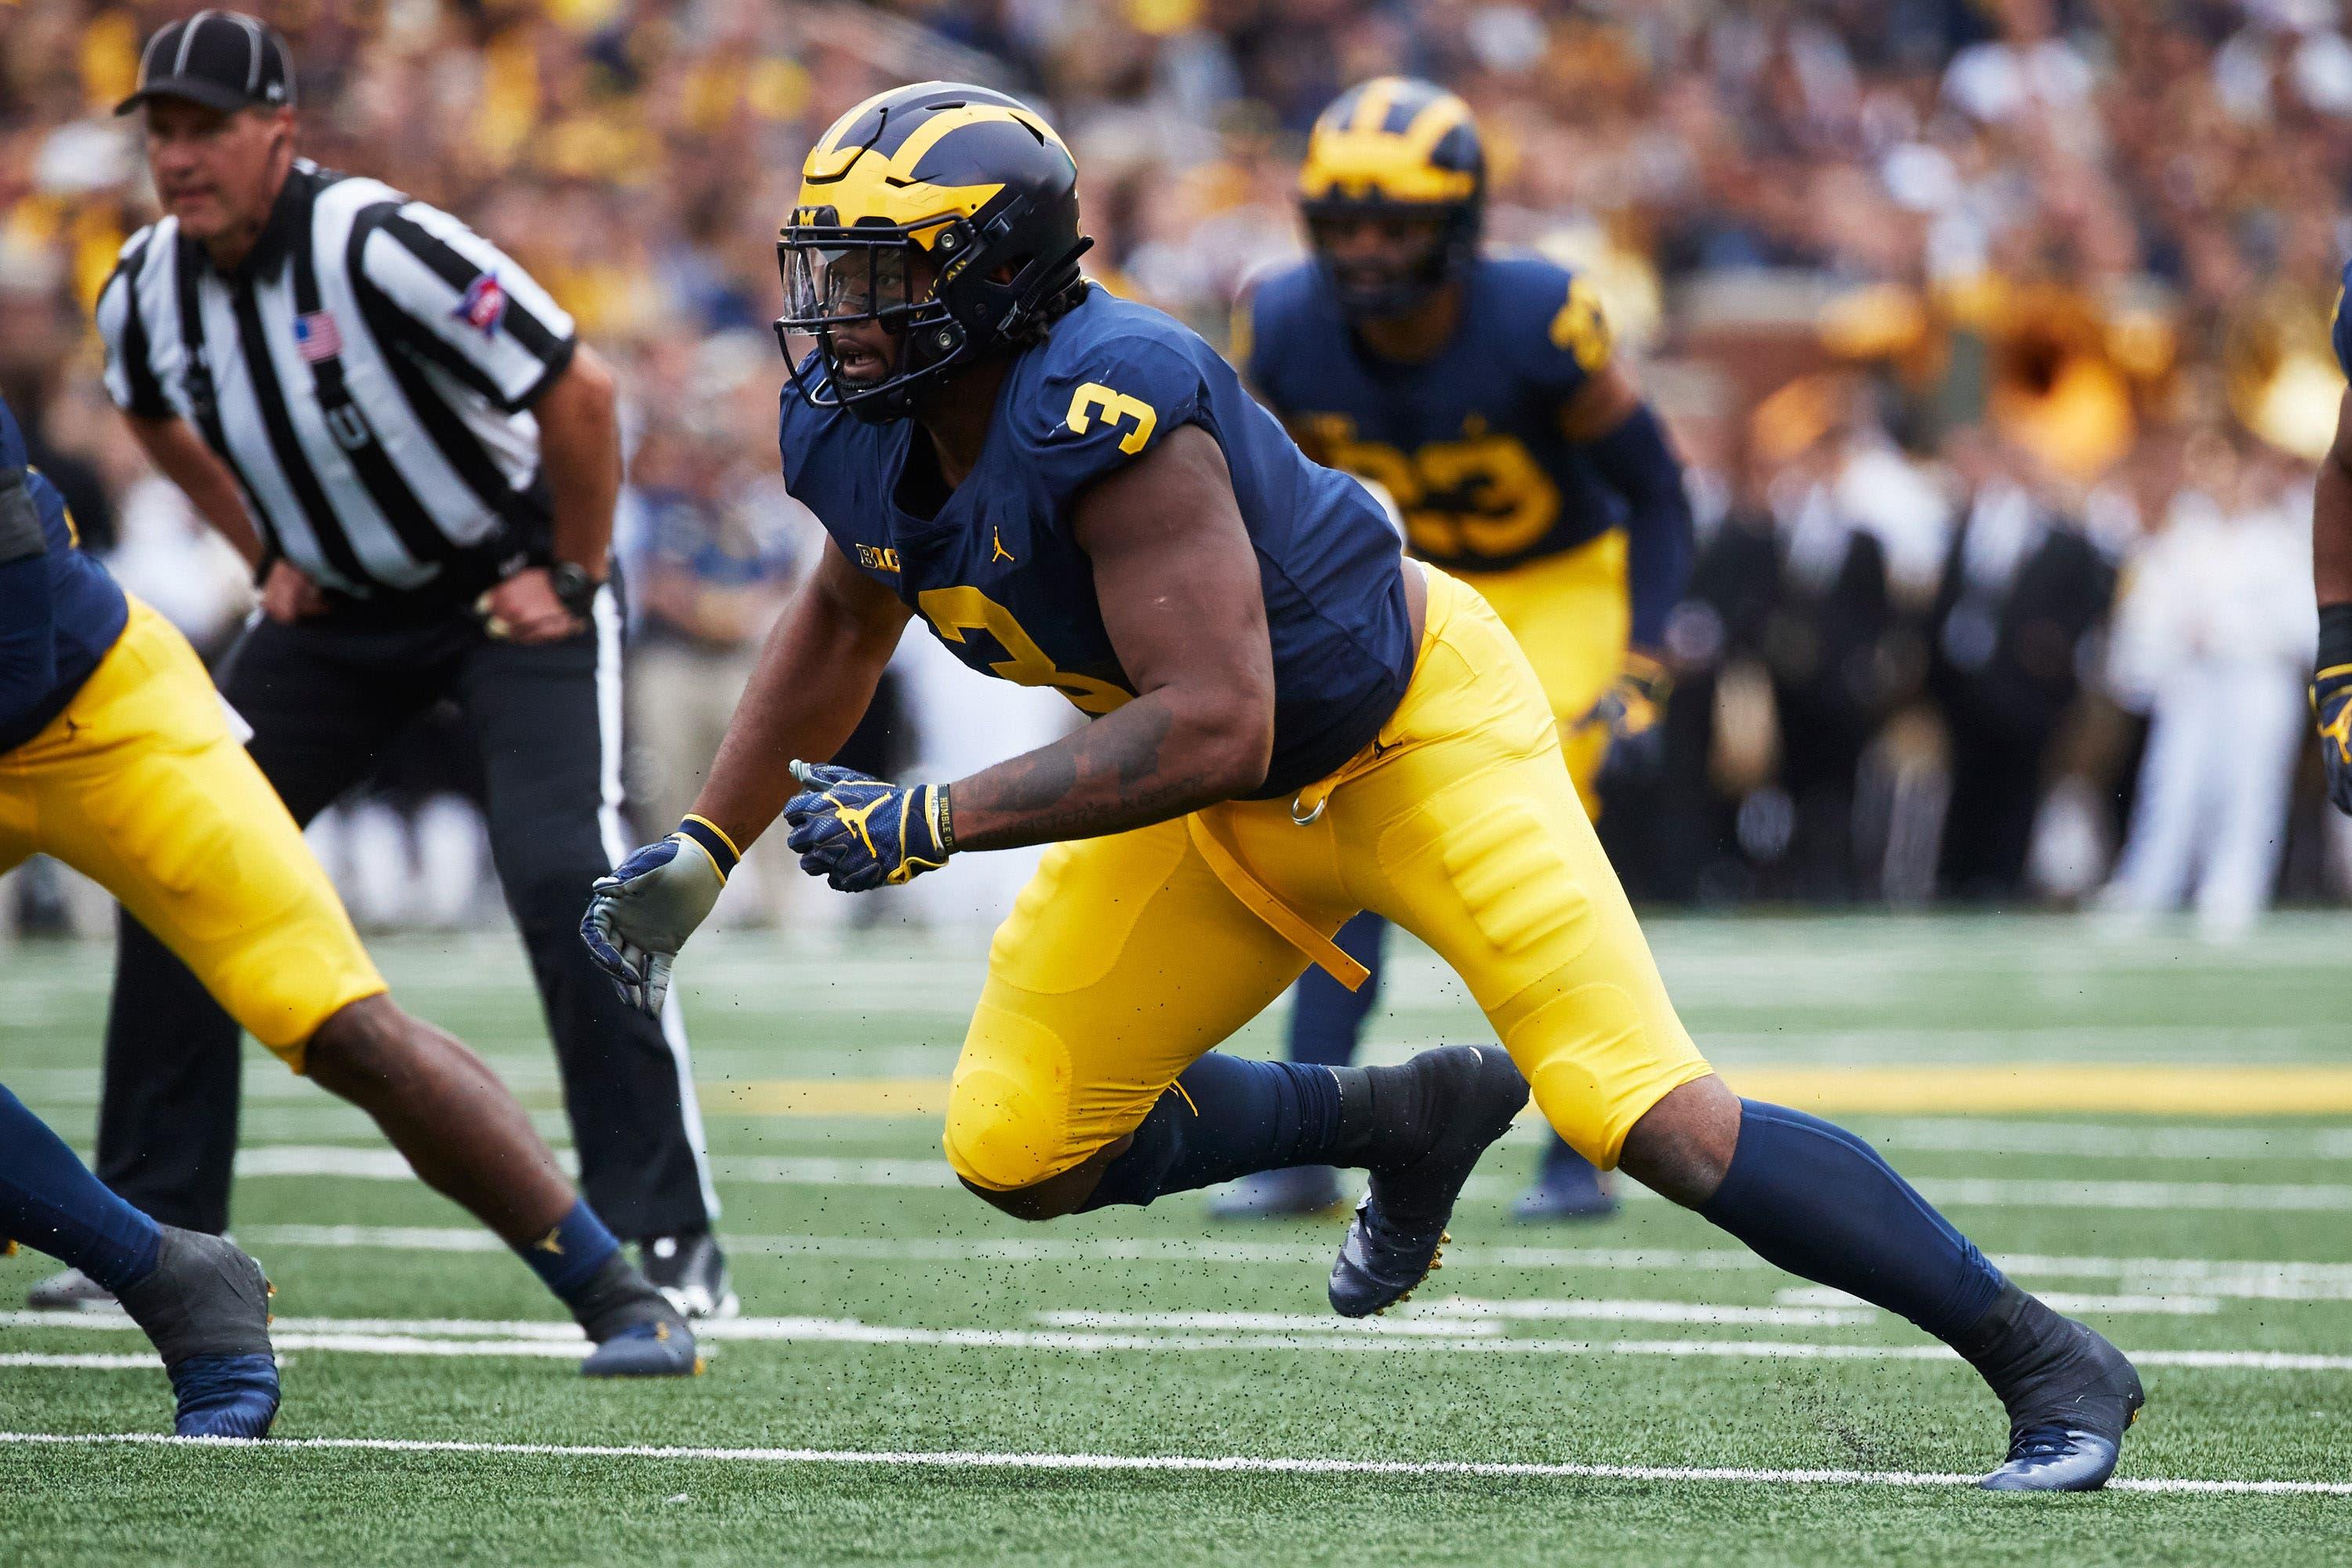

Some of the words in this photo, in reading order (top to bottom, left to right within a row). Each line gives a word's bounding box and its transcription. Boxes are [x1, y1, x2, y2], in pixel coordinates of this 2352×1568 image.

[799, 209, 816, 226] M
[1065, 382, 1157, 455] 3
[918, 585, 1137, 714] 3
[939, 797, 951, 833] HUMBLE
